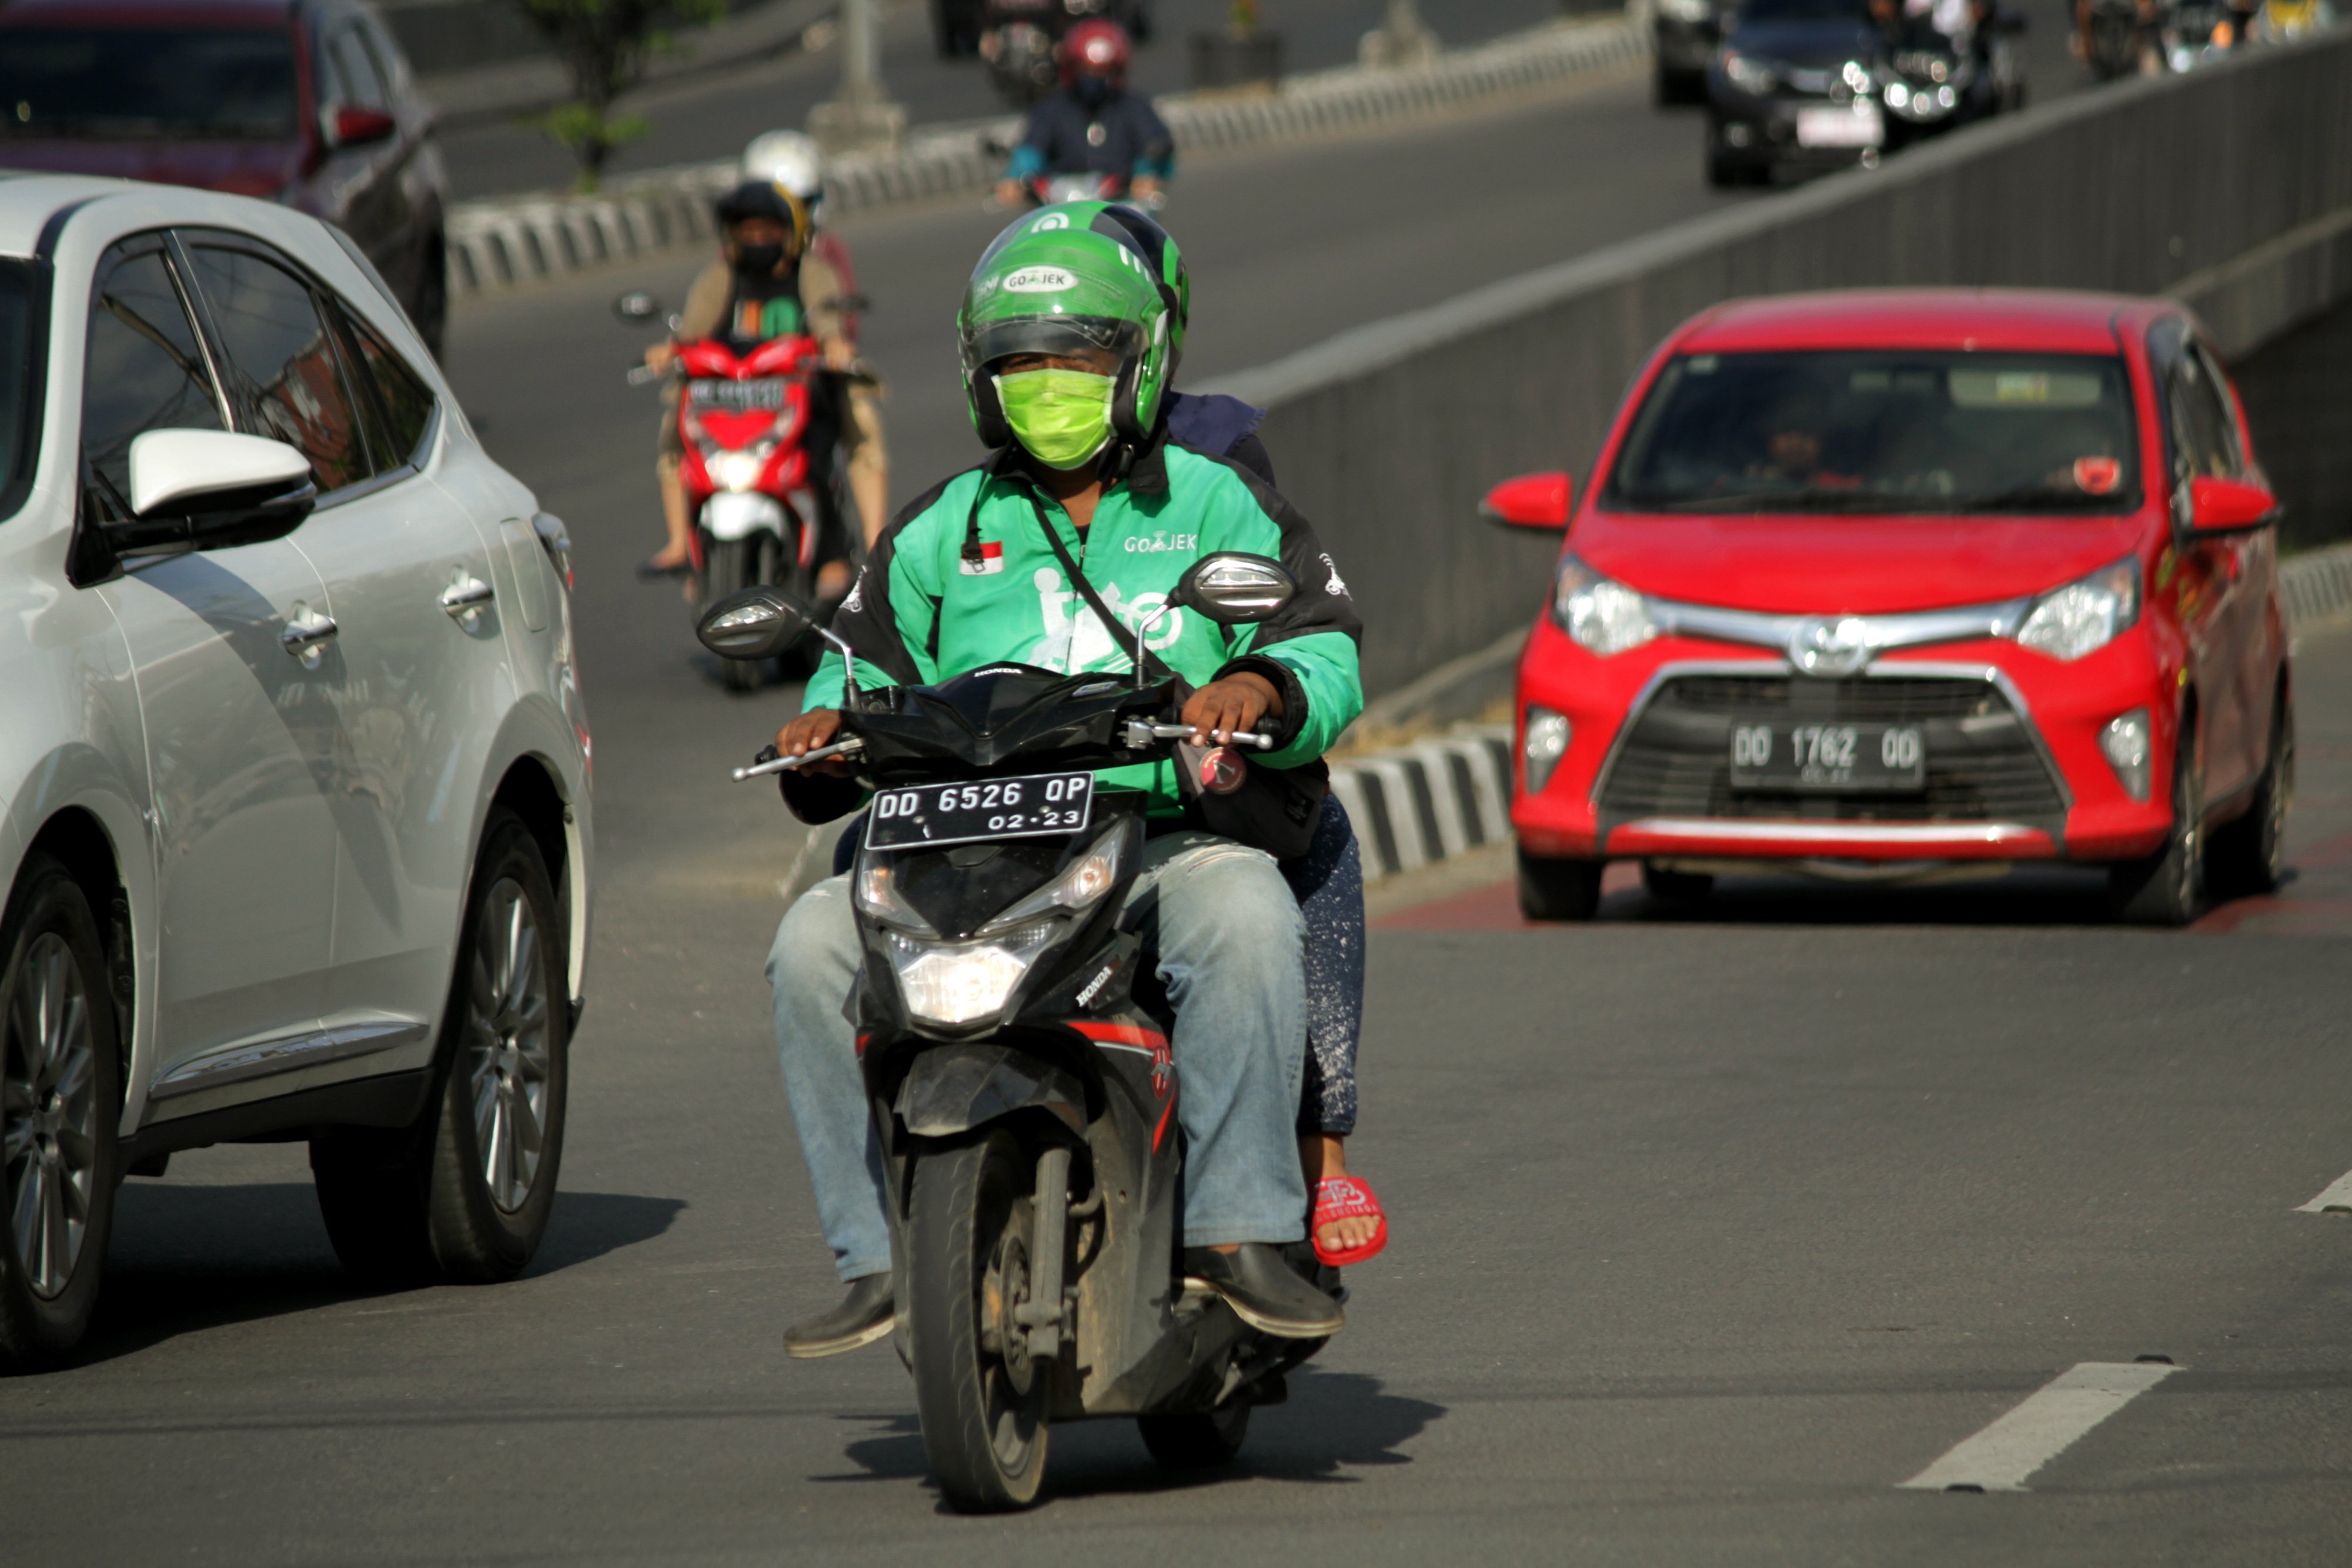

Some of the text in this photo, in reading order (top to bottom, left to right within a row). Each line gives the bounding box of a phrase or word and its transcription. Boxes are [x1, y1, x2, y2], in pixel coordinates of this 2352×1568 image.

[1124, 533, 1198, 553] GO JEK
[974, 667, 1023, 677] HONDA
[1791, 726, 1858, 768] 1762
[877, 793, 920, 818] DD
[938, 783, 1022, 812] 6526
[1075, 966, 1113, 1008] HONDA
